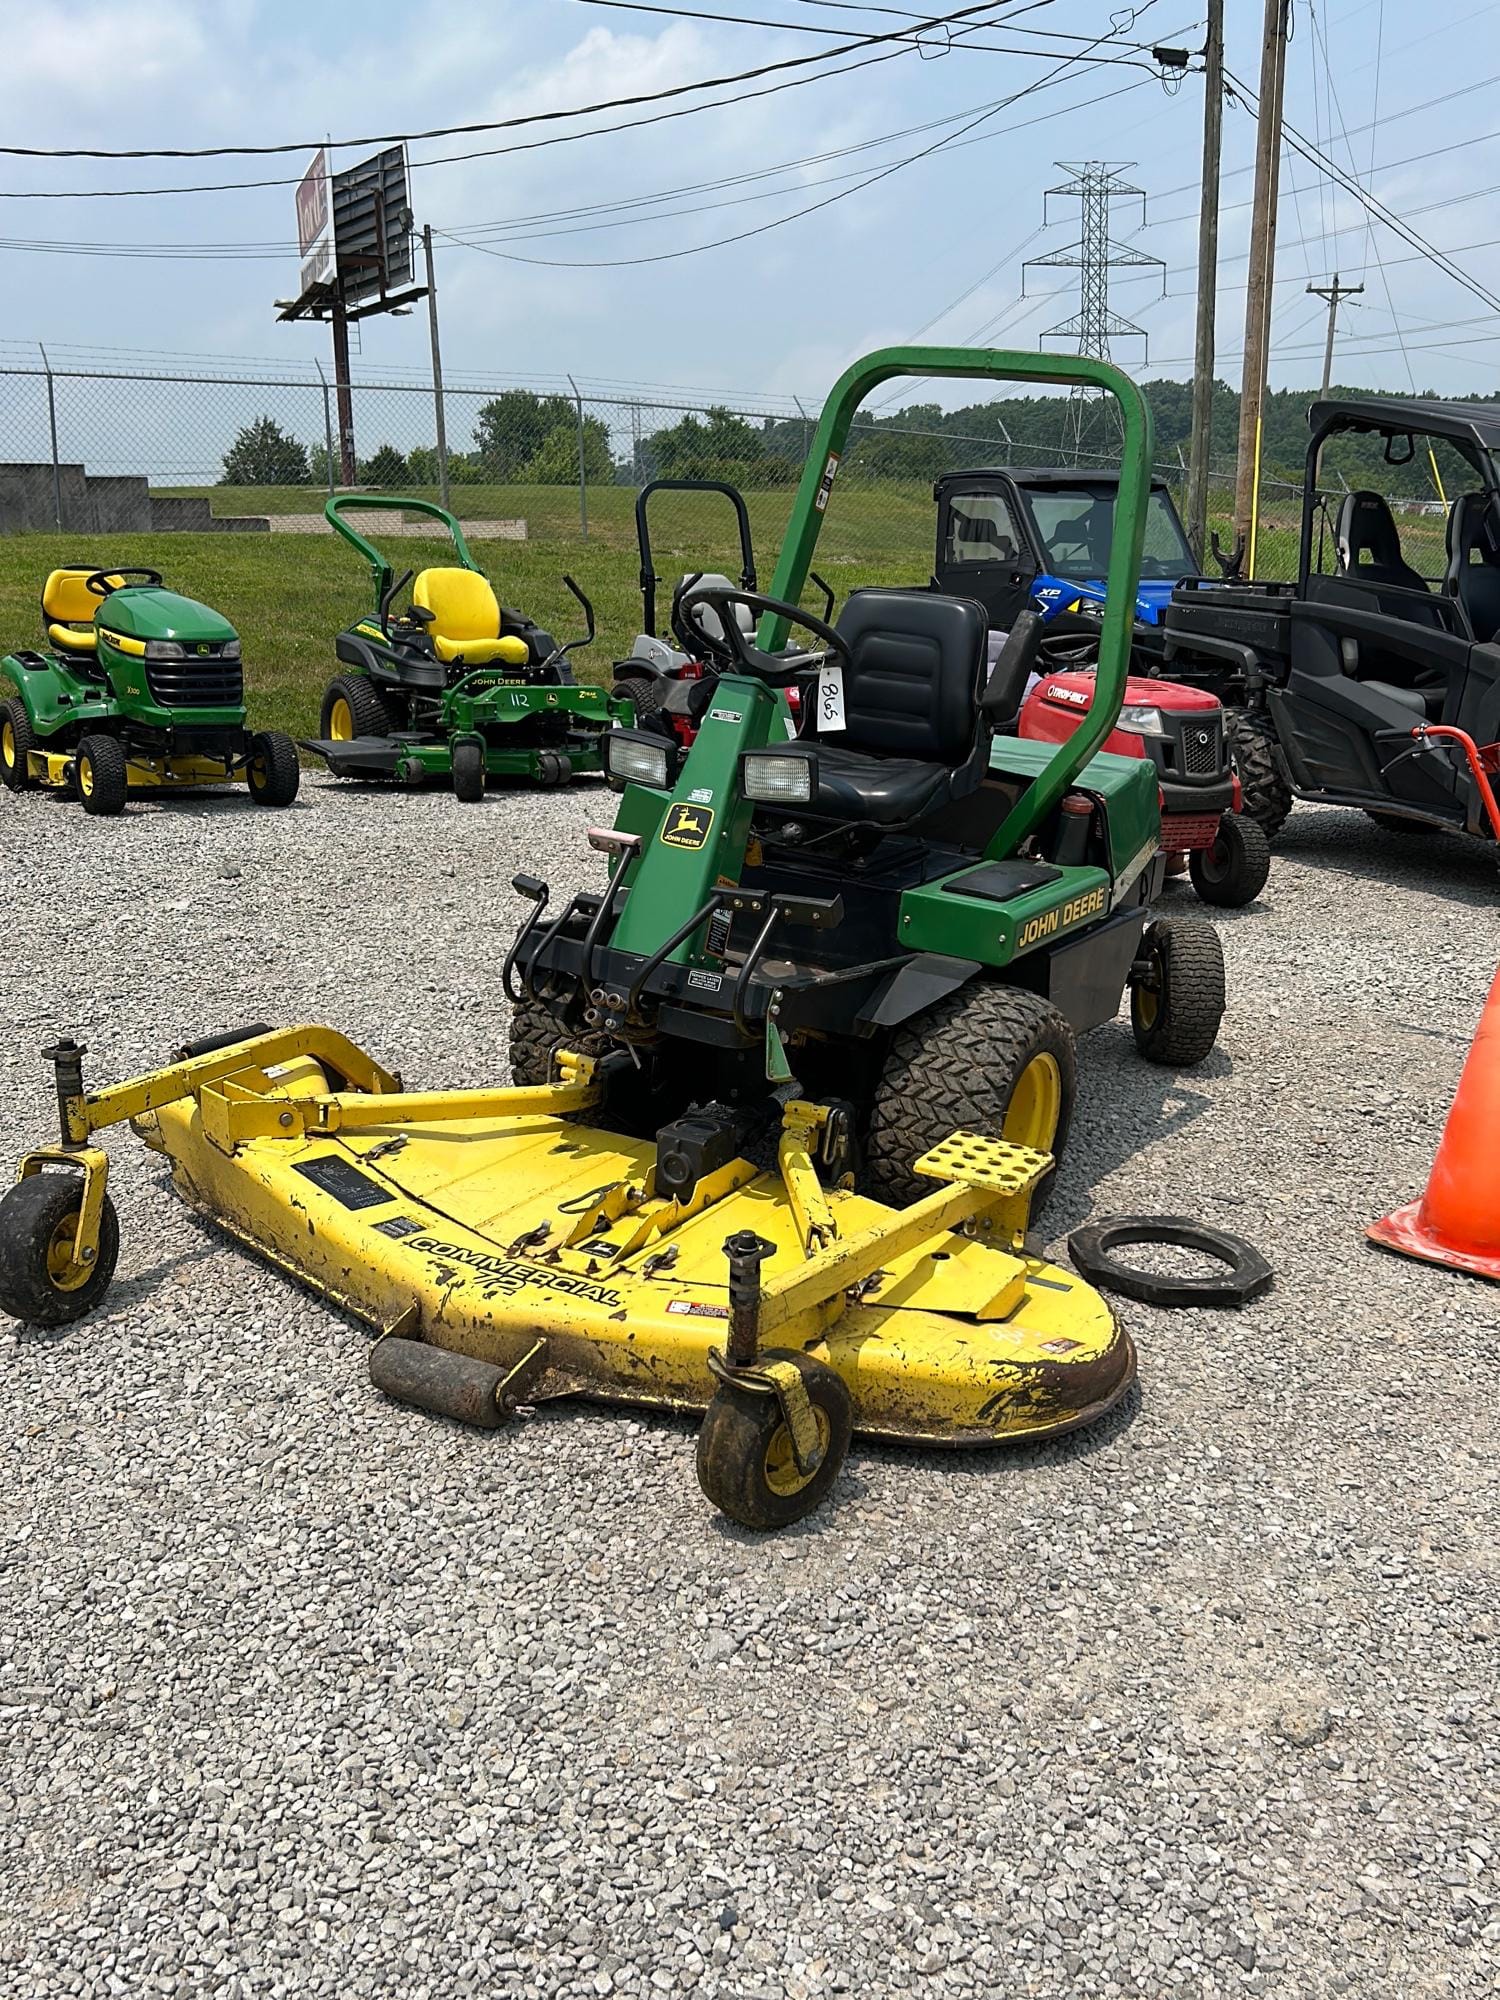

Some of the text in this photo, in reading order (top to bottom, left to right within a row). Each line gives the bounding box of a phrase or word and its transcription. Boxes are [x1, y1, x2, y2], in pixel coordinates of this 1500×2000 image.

[1039, 588, 1062, 597] XP
[497, 678, 527, 686] DEERE
[510, 693, 530, 708] 112
[821, 683, 839, 720] 865
[664, 834, 701, 847] JOHN DEERE
[1019, 887, 1105, 947] JOHN DEERE
[408, 1237, 621, 1307] COMMERCIAL
[473, 1268, 528, 1297] 72
